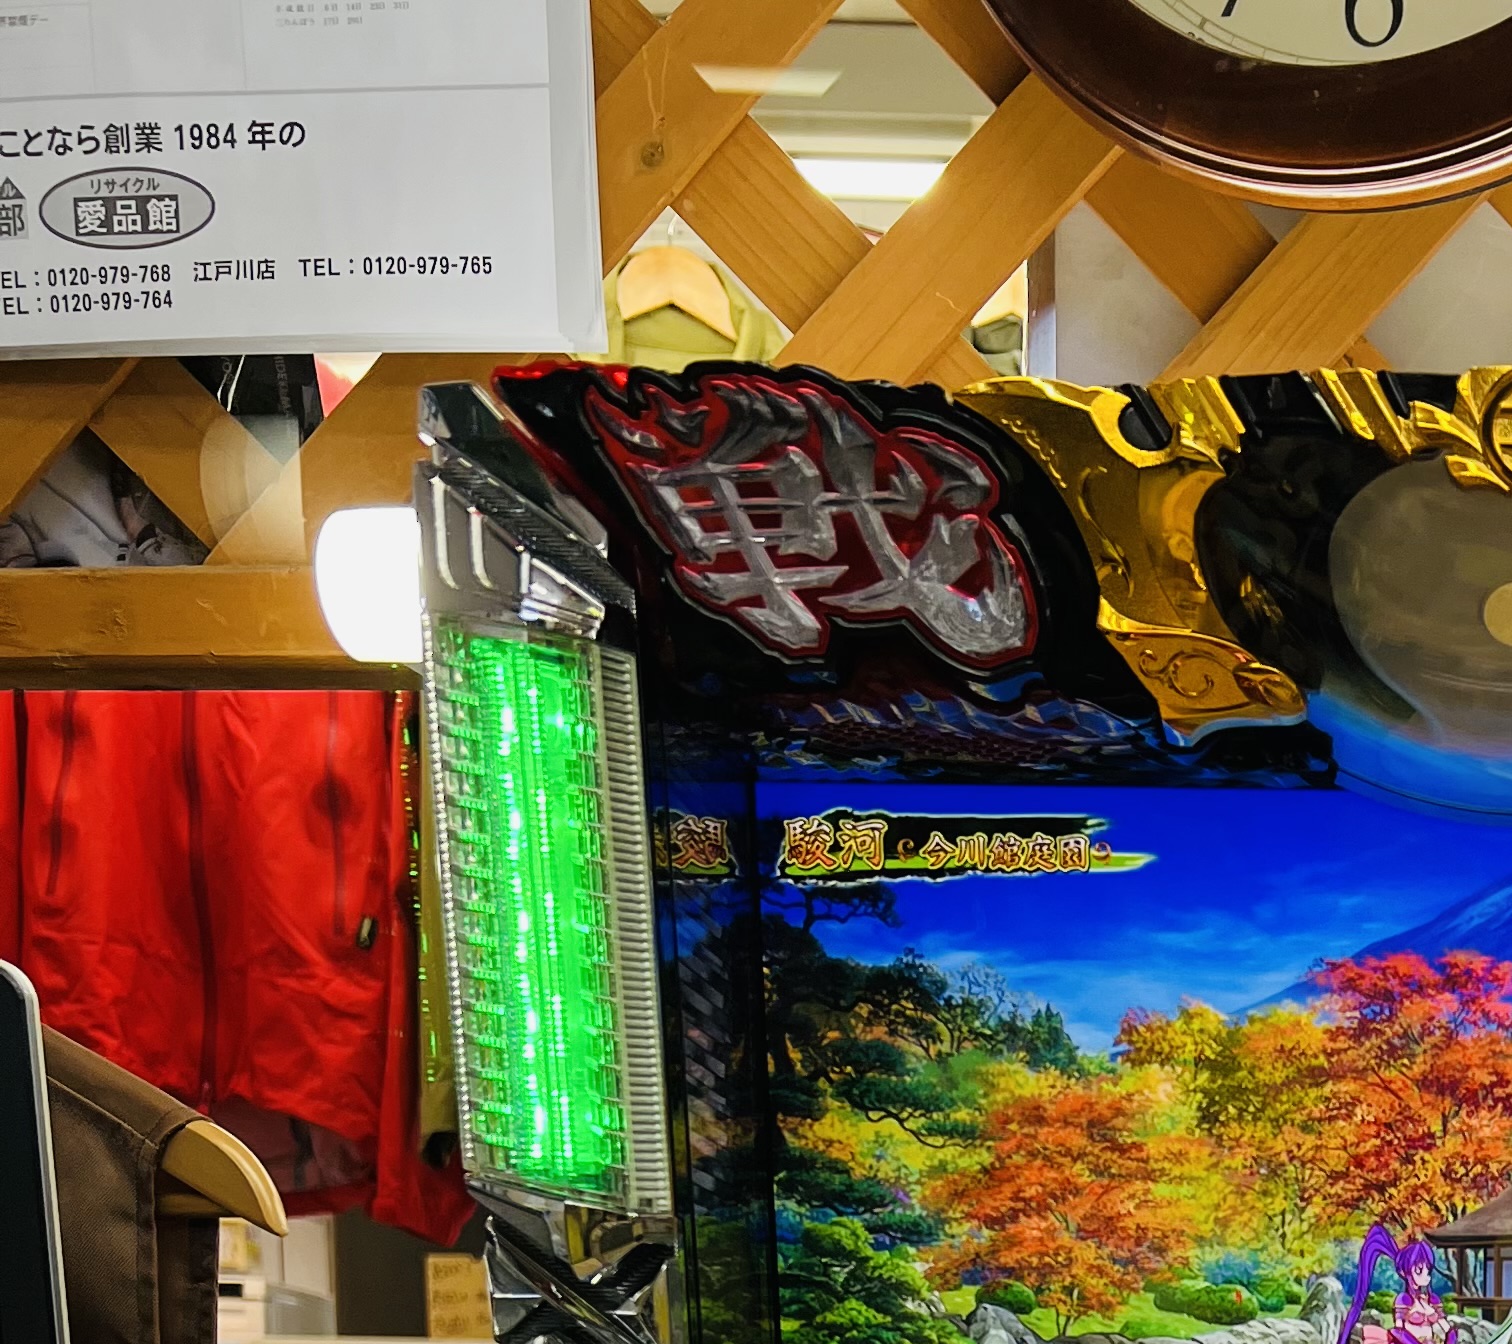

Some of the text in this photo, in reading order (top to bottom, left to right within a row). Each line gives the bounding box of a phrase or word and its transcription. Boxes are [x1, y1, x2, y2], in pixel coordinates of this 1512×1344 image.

[174, 122, 237, 151] 1984
[248, 119, 305, 150] 年の
[89, 177, 160, 195] リサイクル
[75, 198, 179, 235] 愛品館
[193, 259, 276, 283] 江戸川店
[784, 816, 888, 869] 駿河
